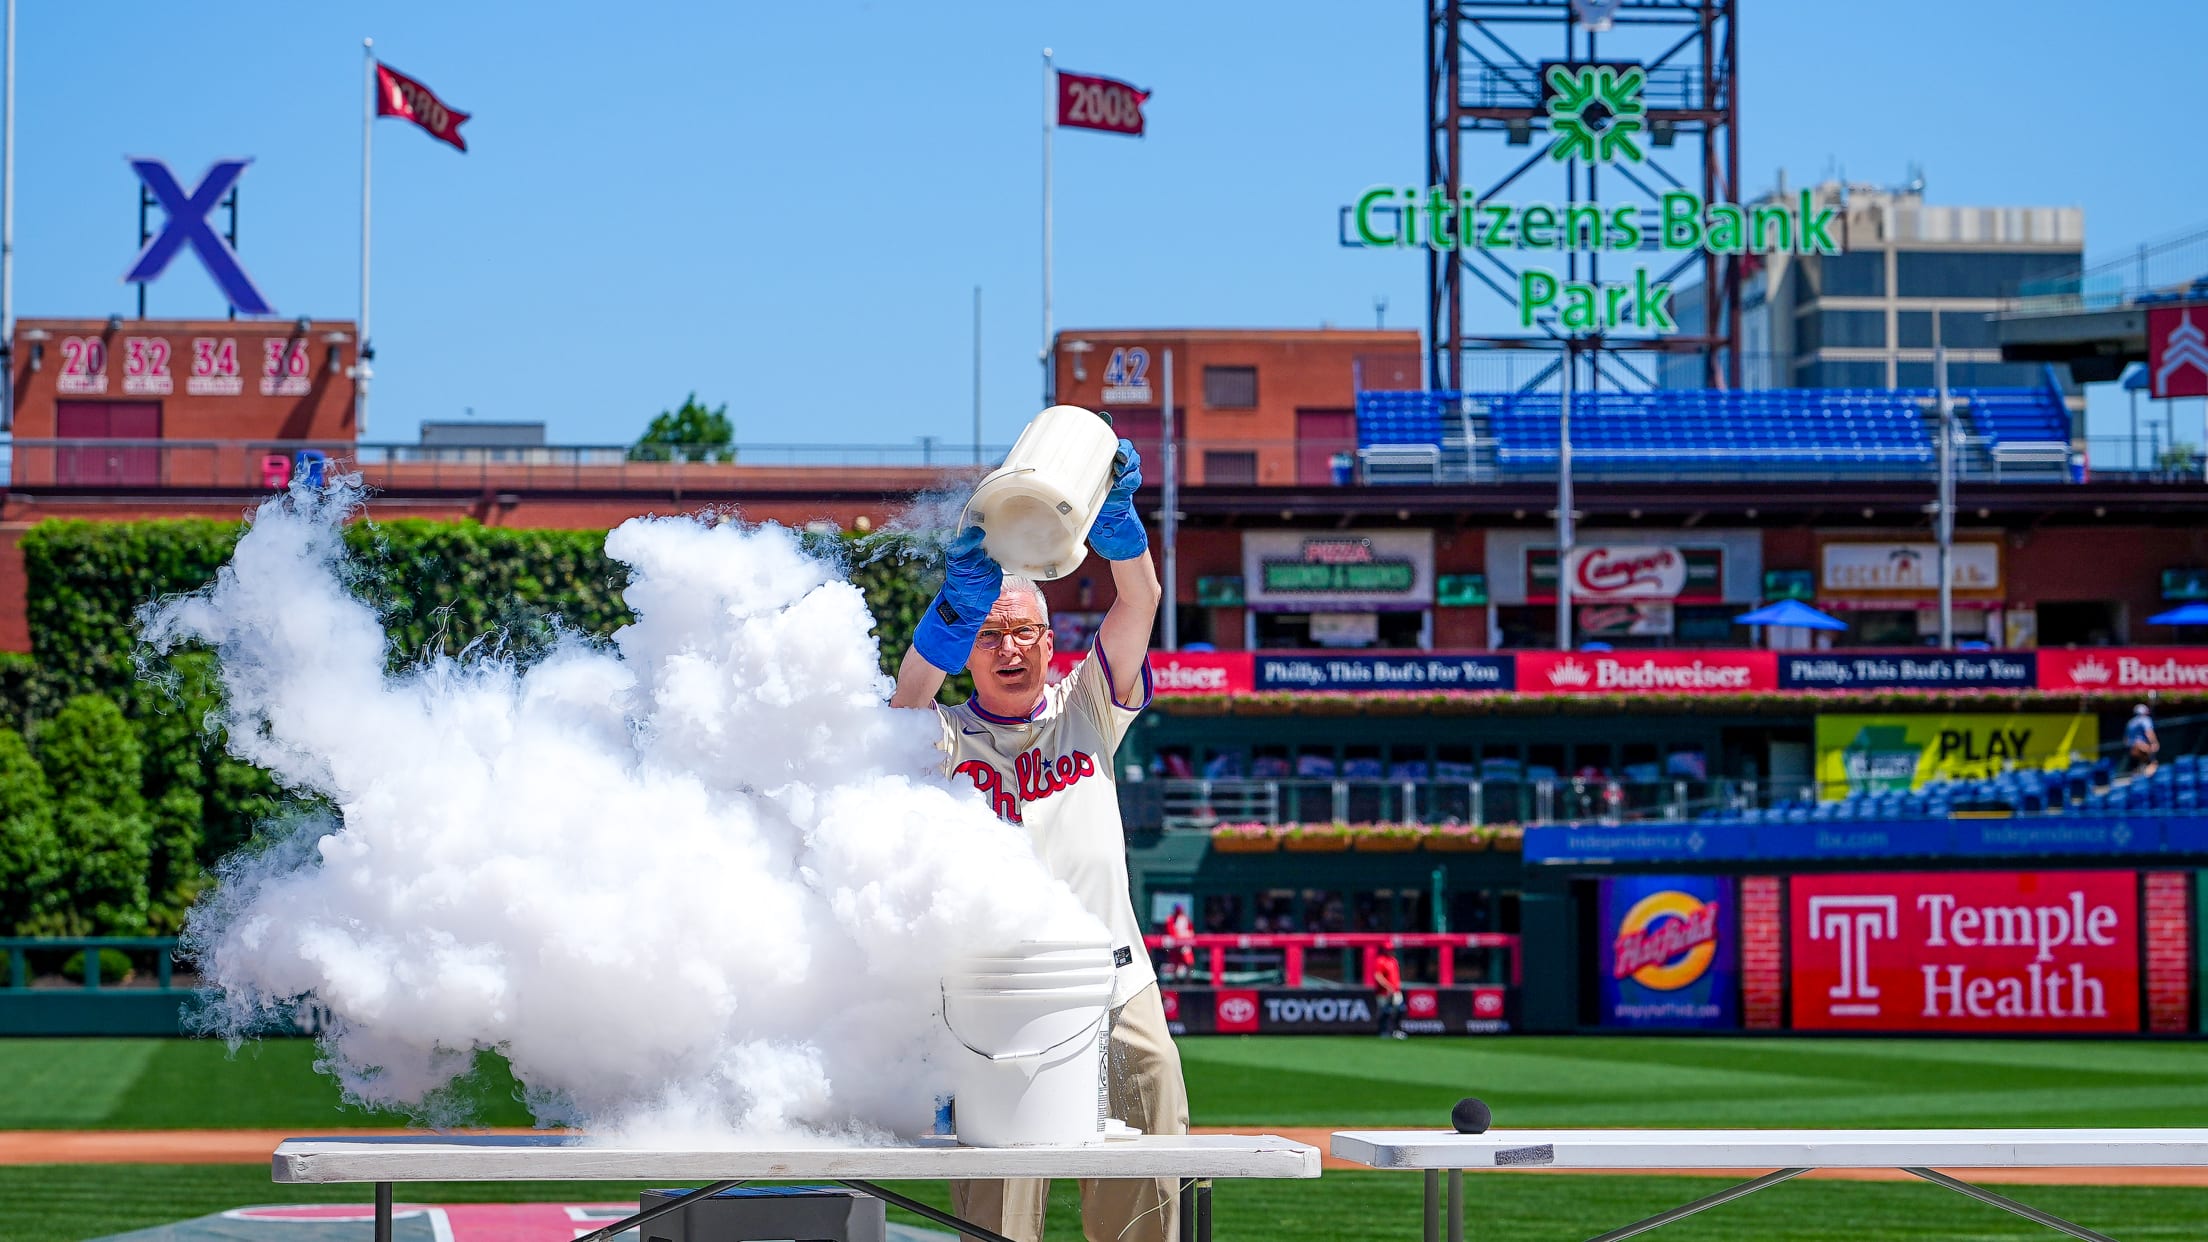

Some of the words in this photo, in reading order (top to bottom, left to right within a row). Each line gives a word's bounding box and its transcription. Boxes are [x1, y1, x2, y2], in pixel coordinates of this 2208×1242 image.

[1356, 186, 1641, 251] Citizens
[1660, 188, 1840, 254] Bank
[1519, 267, 1676, 333] Park
[61, 337, 107, 376] 20
[124, 337, 171, 377] 32
[192, 338, 239, 377] 34
[264, 338, 309, 377] 36
[1104, 348, 1150, 387] 42
[1152, 661, 1228, 689] eiser
[1265, 661, 1326, 686] Philly,
[1326, 661, 1371, 682] This
[1373, 661, 1426, 682] Bud's
[1427, 661, 1460, 682] For
[1461, 661, 1499, 682] You
[1596, 658, 1750, 688] Budweiser
[1791, 660, 1853, 684] Philly,
[1853, 660, 1898, 681] This
[1900, 660, 1952, 681] Bud's
[1954, 659, 1987, 680] For
[1988, 659, 2026, 680] You
[2117, 656, 2208, 685] Budwe
[1940, 729, 2031, 761] PLAY
[952, 748, 1095, 824] Phllies
[1917, 891, 2118, 961] Temple
[1921, 963, 2108, 1017] Health
[1265, 998, 1371, 1022] TOYOTA
